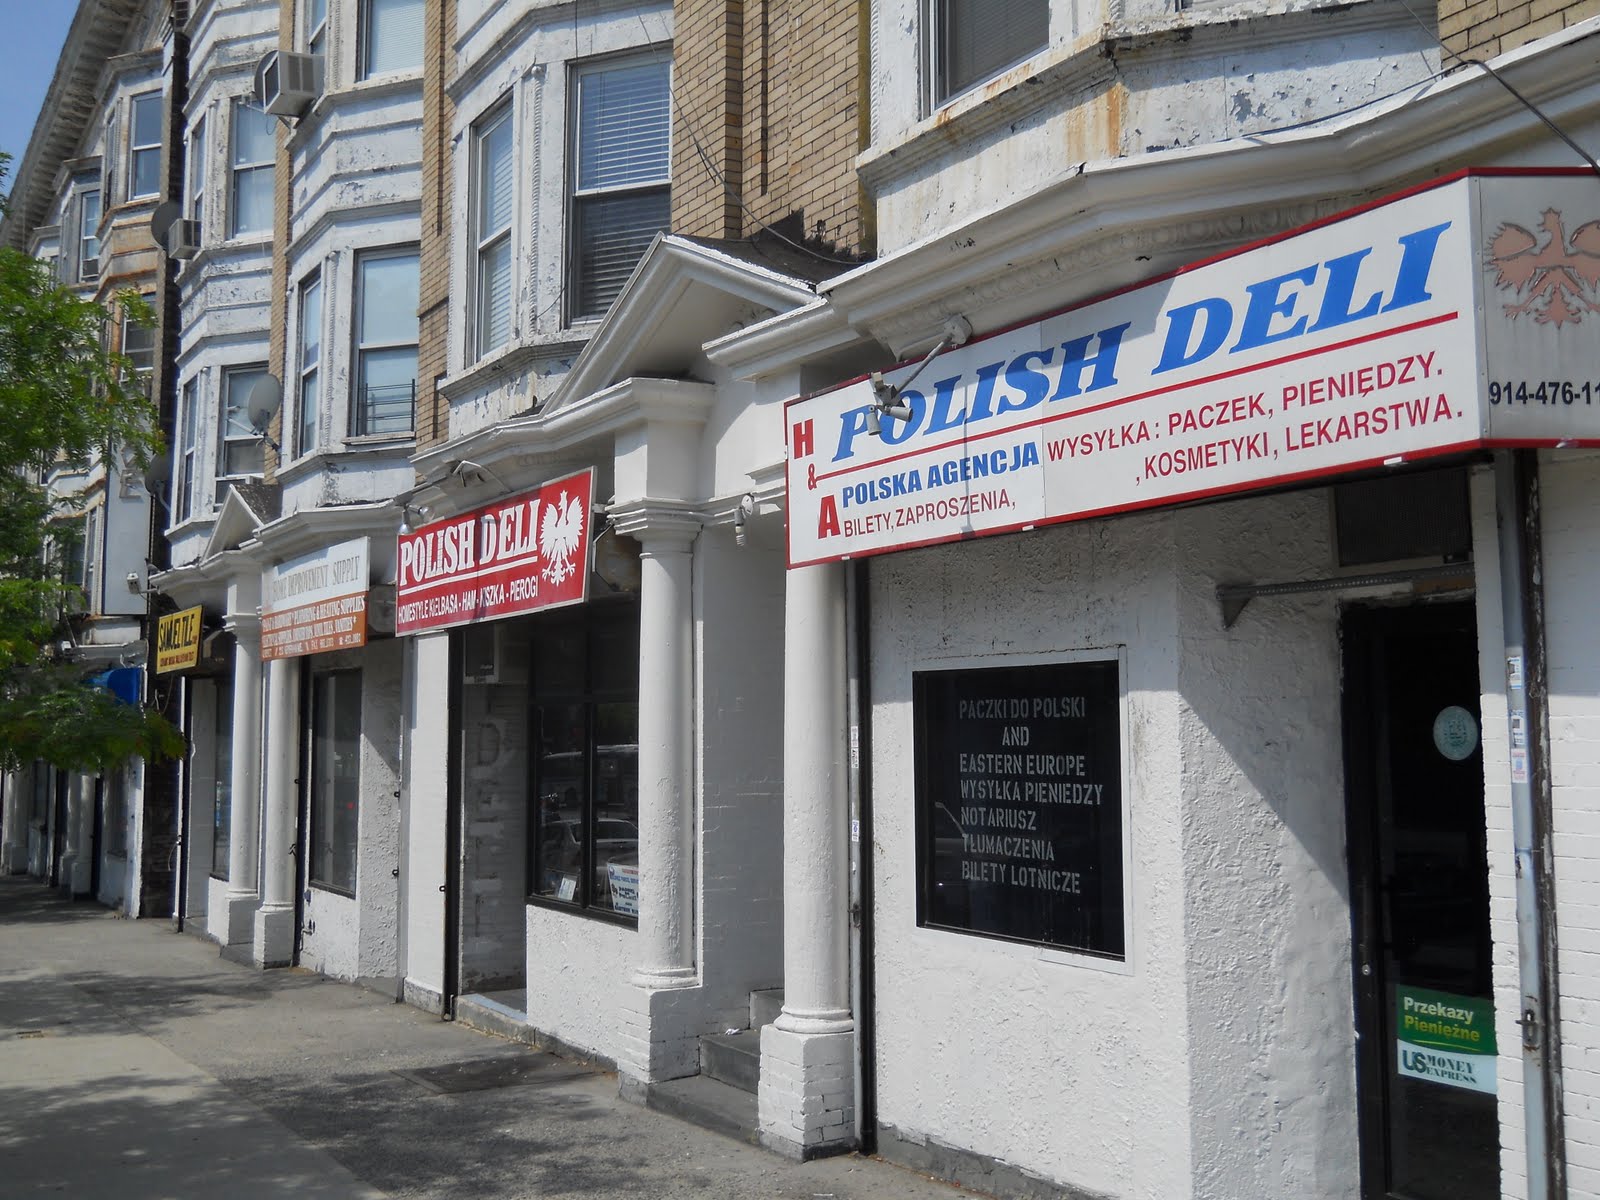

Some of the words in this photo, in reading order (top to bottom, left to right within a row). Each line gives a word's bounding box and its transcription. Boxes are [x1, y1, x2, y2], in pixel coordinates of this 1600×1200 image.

[831, 321, 1131, 463] POLISH
[1152, 221, 1452, 375] DELI
[1168, 392, 1273, 436] PACZEK,
[1282, 350, 1443, 411] PIENIĘDZY.
[793, 418, 814, 460] H
[808, 463, 818, 491] &
[842, 469, 922, 508] POLSKA
[927, 441, 1039, 488] AGENCJA
[818, 494, 841, 539] A
[400, 519, 475, 586] POLISH
[480, 499, 540, 565] DELI
[288, 564, 329, 598] IMPROVEMENT
[332, 556, 360, 586] SUPPLY
[340, 595, 366, 615] SUPPLIES
[398, 598, 429, 625] HOMESTYLE
[428, 593, 459, 618] KIELBASA
[461, 589, 477, 612] HAM
[509, 575, 539, 602] PIEROGI
[959, 699, 1007, 719] PACZKI
[1010, 698, 1029, 719] DO
[1033, 696, 1086, 718] POLSKI
[1002, 726, 1030, 746] AND
[959, 753, 1023, 774] EASTERN
[1026, 754, 1086, 776] EUROPE
[960, 779, 1021, 801] WYSYŁKA
[1025, 782, 1103, 805] PIENIEDZY
[961, 806, 1037, 831] NOTARIUSZ
[961, 832, 1055, 861] TŁUMACZENIA
[961, 860, 1007, 884] BILETY
[1011, 865, 1081, 894] LOTNICZE
[1403, 996, 1474, 1025] Przekazy
[1402, 1049, 1427, 1074] US
[1426, 1054, 1475, 1074] MONEY
[1426, 1066, 1477, 1084] EXPRESS
